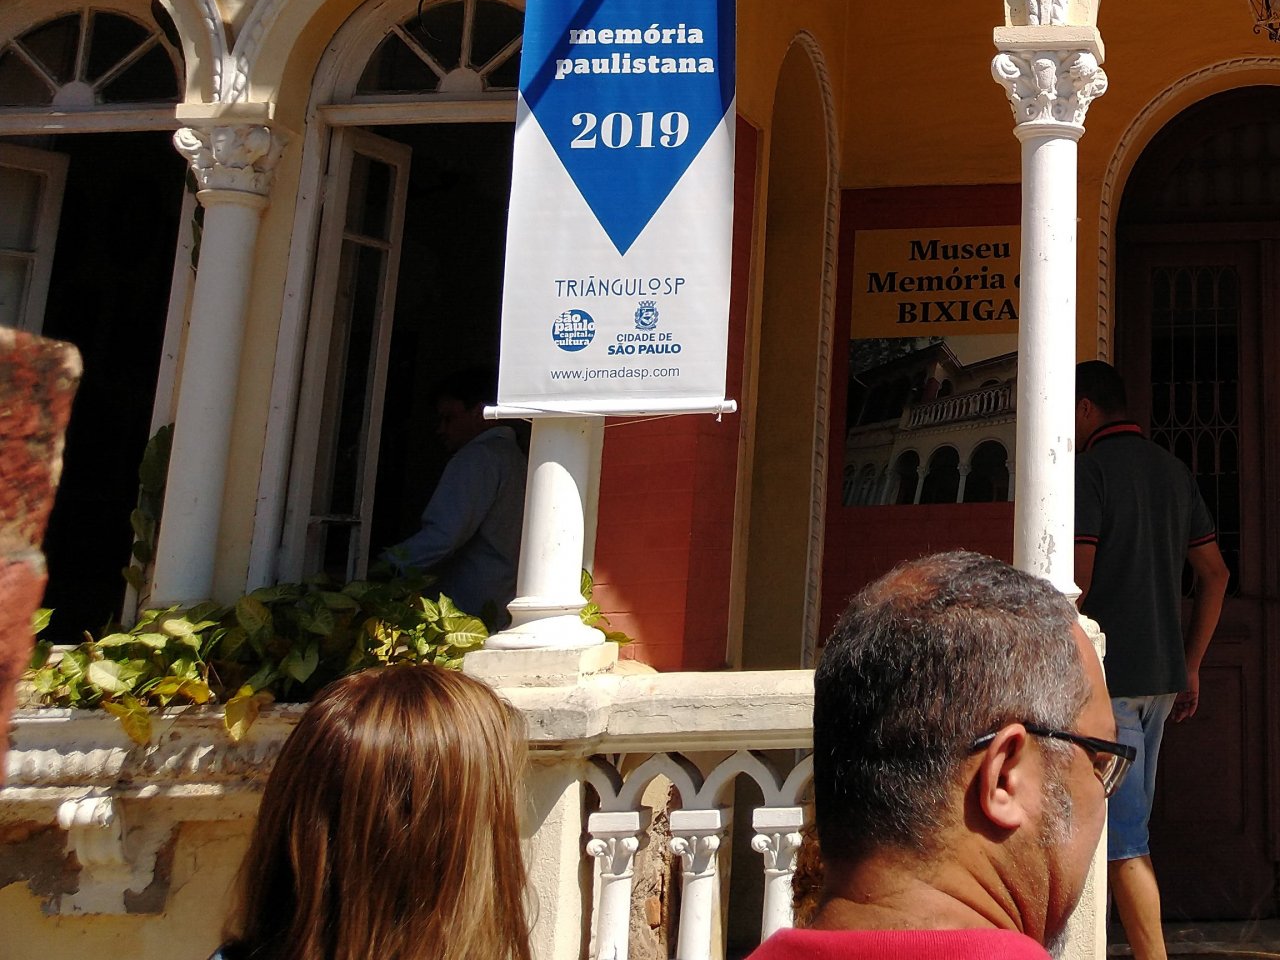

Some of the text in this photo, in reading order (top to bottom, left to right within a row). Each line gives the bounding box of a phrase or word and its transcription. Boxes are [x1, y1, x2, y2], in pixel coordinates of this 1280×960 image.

[569, 23, 704, 45] memória
[555, 52, 715, 80] paulistana
[570, 111, 690, 150] 2019
[909, 238, 1011, 261] Museu
[866, 266, 1005, 294] Memória
[896, 299, 1019, 324] BIXIGA
[554, 319, 596, 334] paulo
[616, 332, 673, 342] CIDADE DE
[607, 343, 682, 355] SÃO PAULO
[550, 366, 680, 381] www.jornadasp.com
